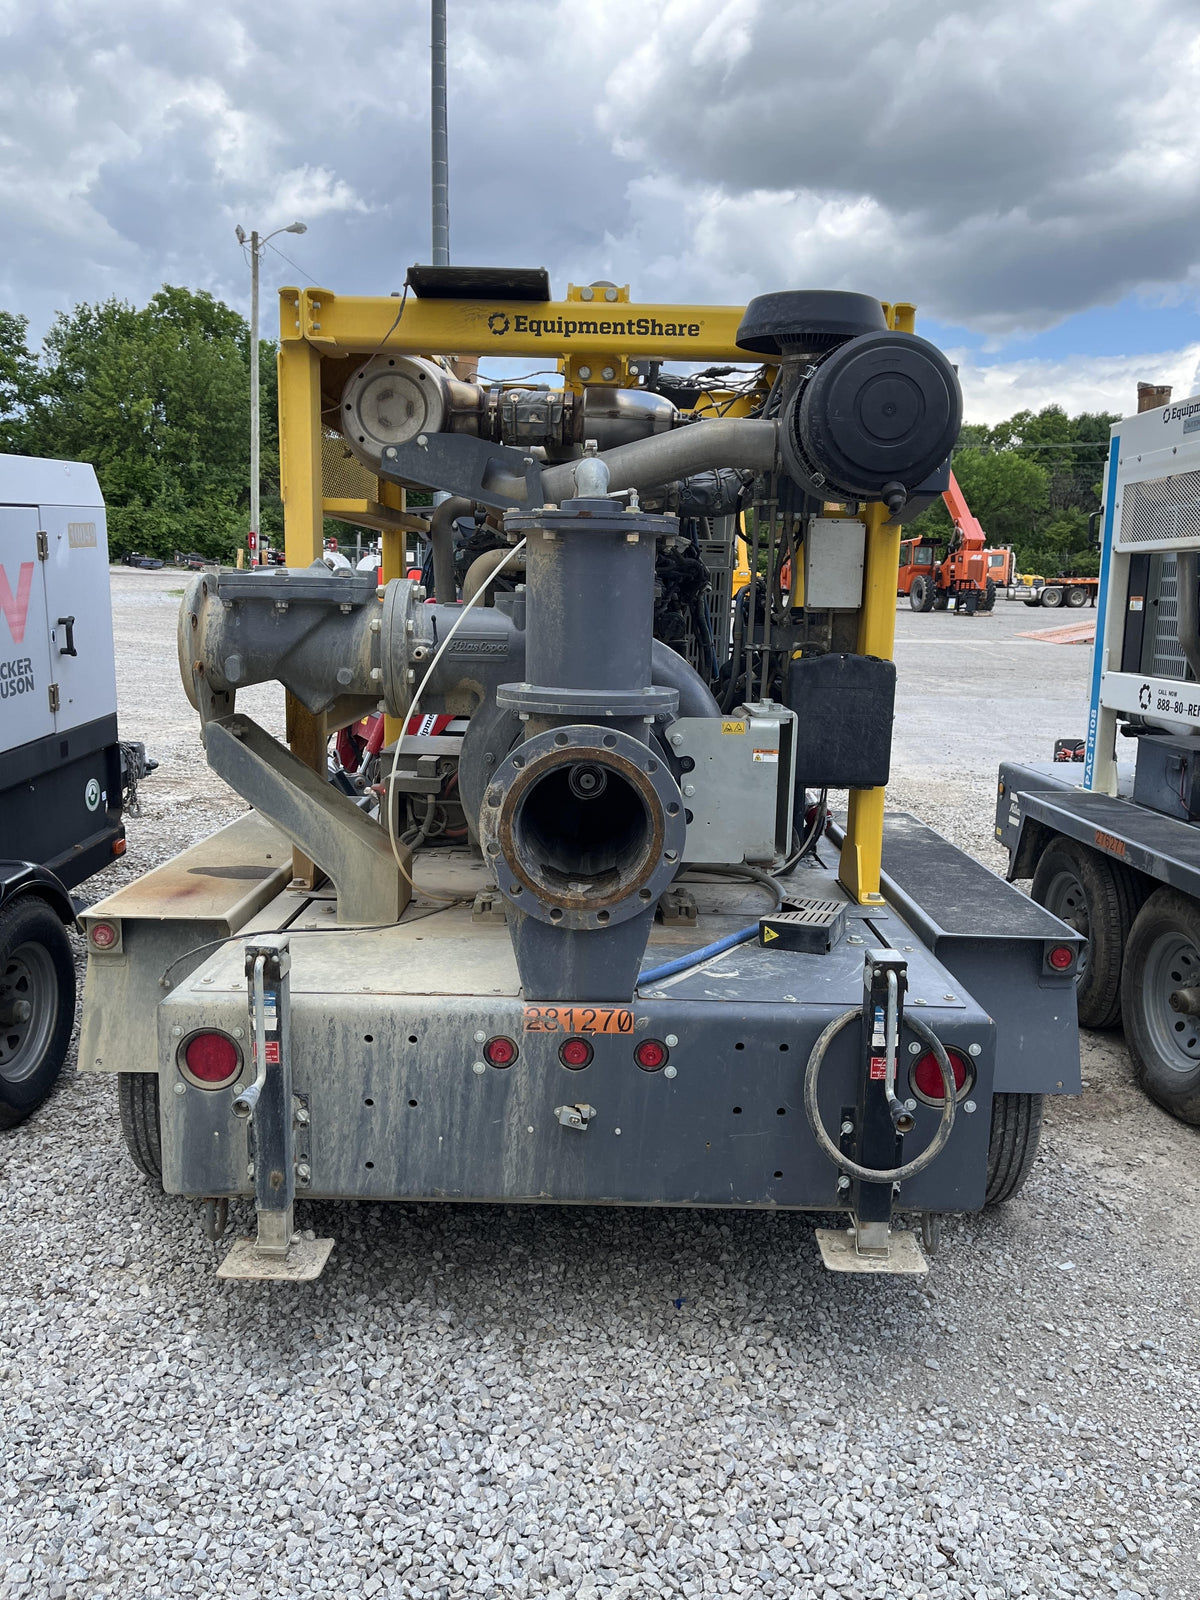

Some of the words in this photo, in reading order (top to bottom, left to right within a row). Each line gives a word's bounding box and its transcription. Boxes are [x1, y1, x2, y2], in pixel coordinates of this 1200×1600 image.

[514, 315, 700, 337] EquipmentShare
[448, 641, 478, 652] Atlas
[480, 641, 508, 653] Copco
[0, 674, 35, 699] USON
[1085, 753, 1093, 786] PAC
[525, 1007, 633, 1033] 281270
